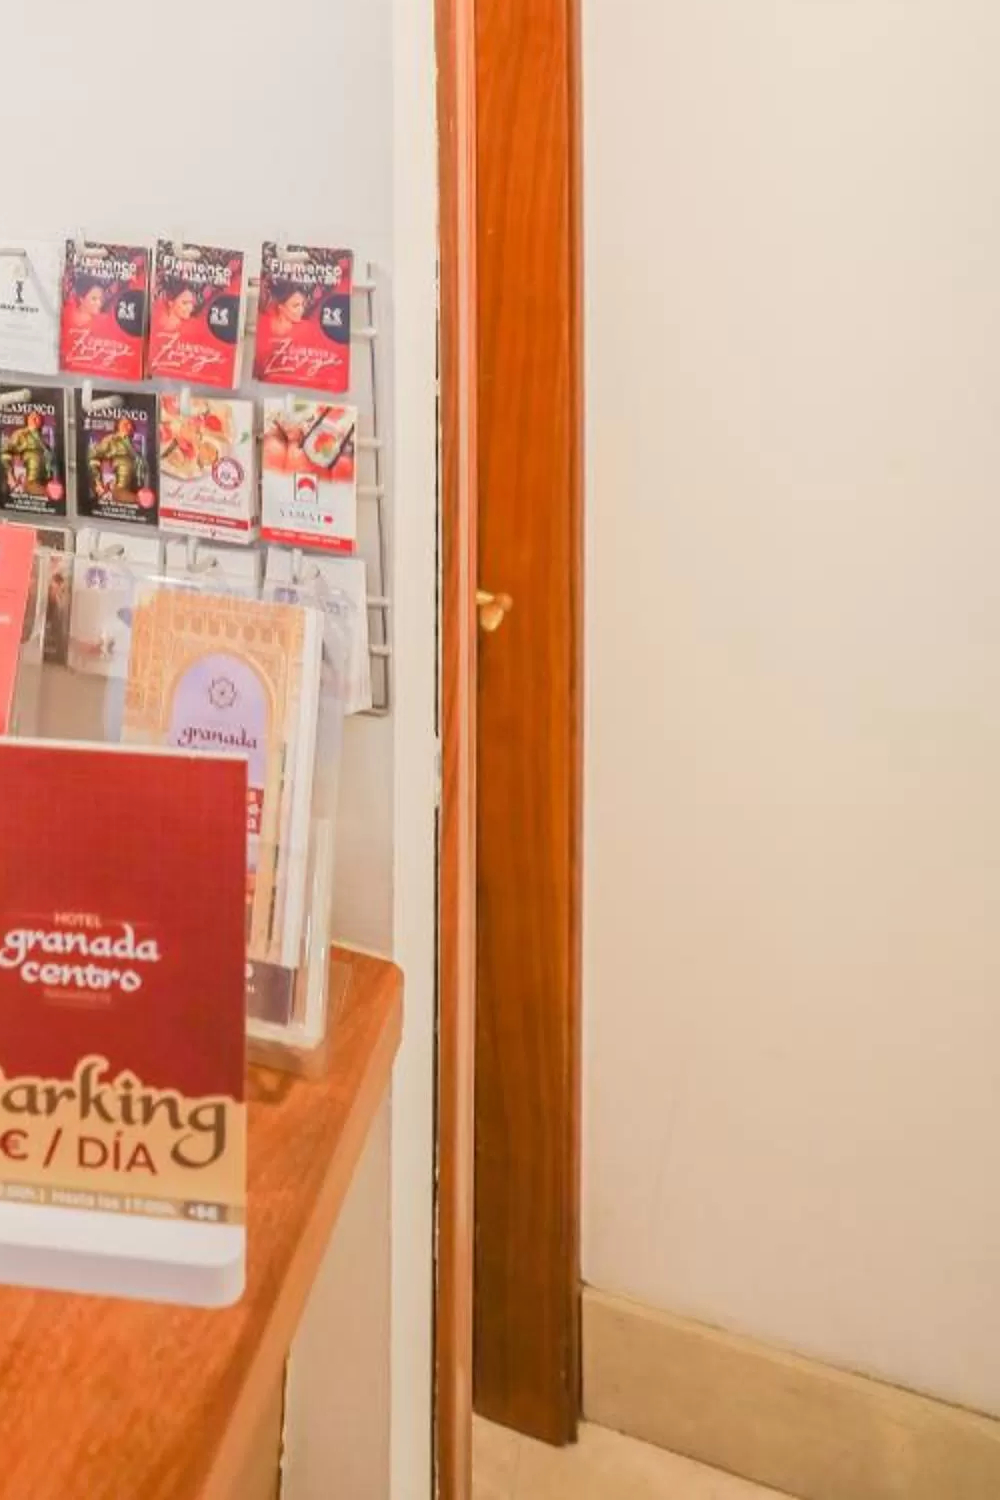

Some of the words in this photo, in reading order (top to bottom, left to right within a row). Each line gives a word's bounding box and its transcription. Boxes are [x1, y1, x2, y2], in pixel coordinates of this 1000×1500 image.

[176, 723, 258, 751] granada
[53, 911, 103, 929] HOTEL
[20, 960, 142, 993] centro
[43, 1127, 63, 1169] /
[77, 1130, 159, 1176] DÍA
